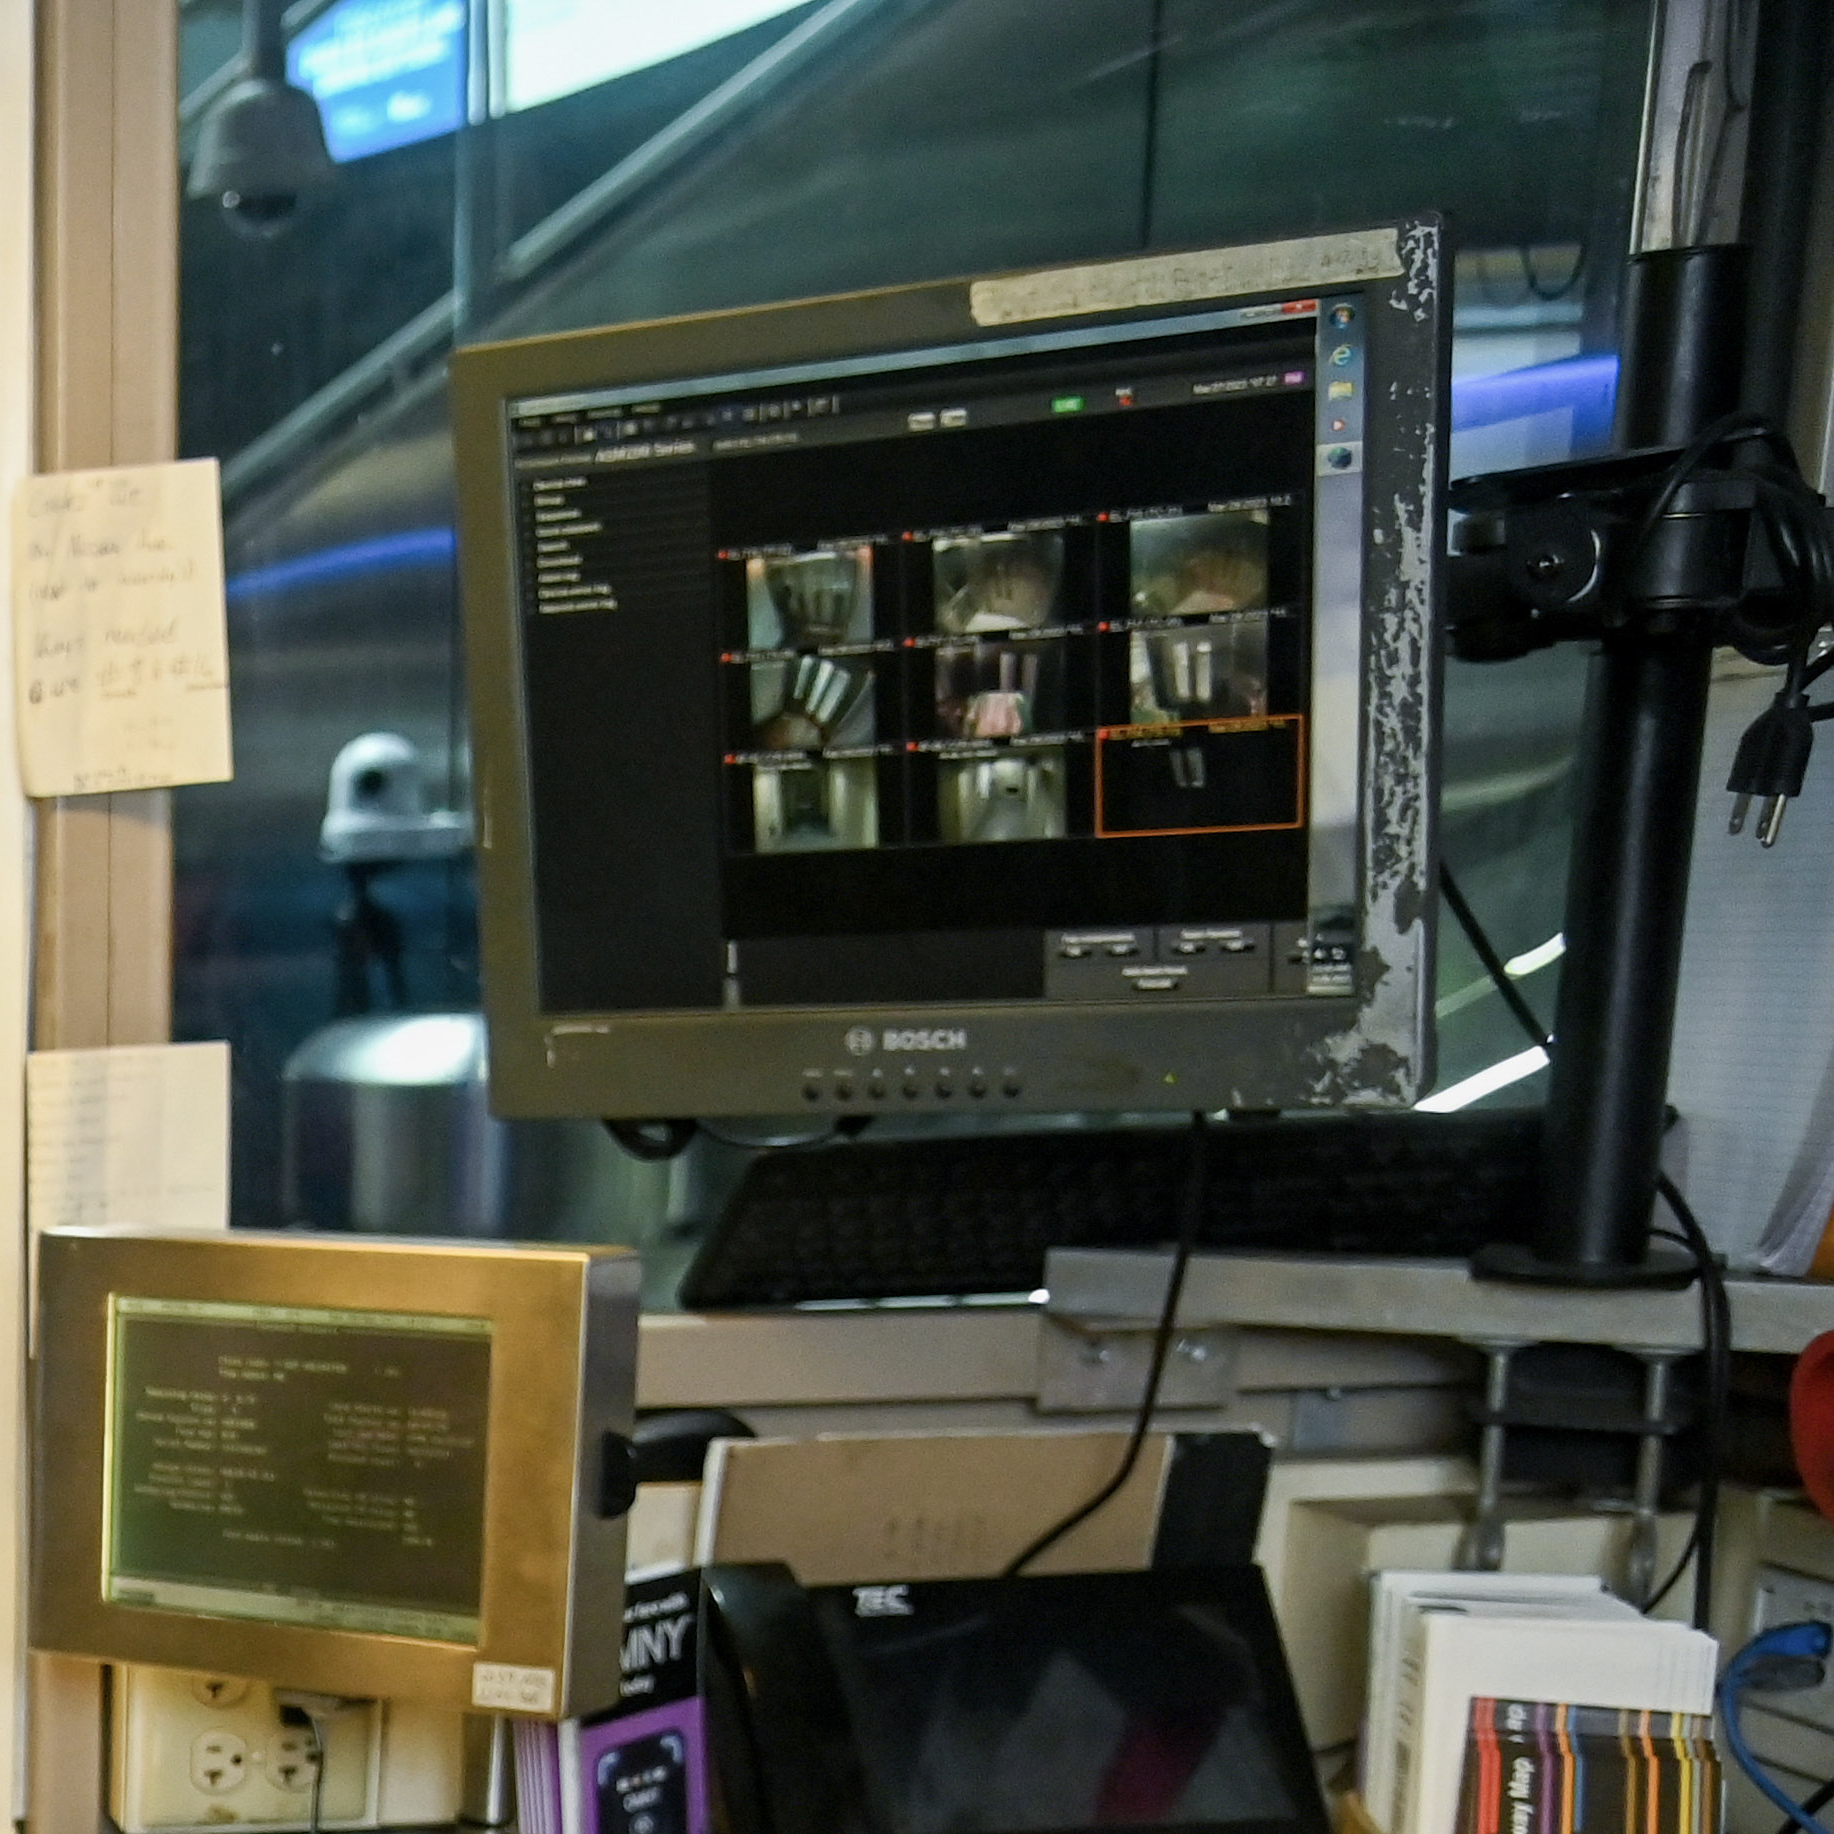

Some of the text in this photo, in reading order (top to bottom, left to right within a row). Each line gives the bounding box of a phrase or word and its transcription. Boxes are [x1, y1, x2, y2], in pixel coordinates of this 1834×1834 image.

[882, 1028, 967, 1050] BOSCH
[620, 1612, 694, 1672] MNY
[1507, 1756, 1536, 1799] Map
